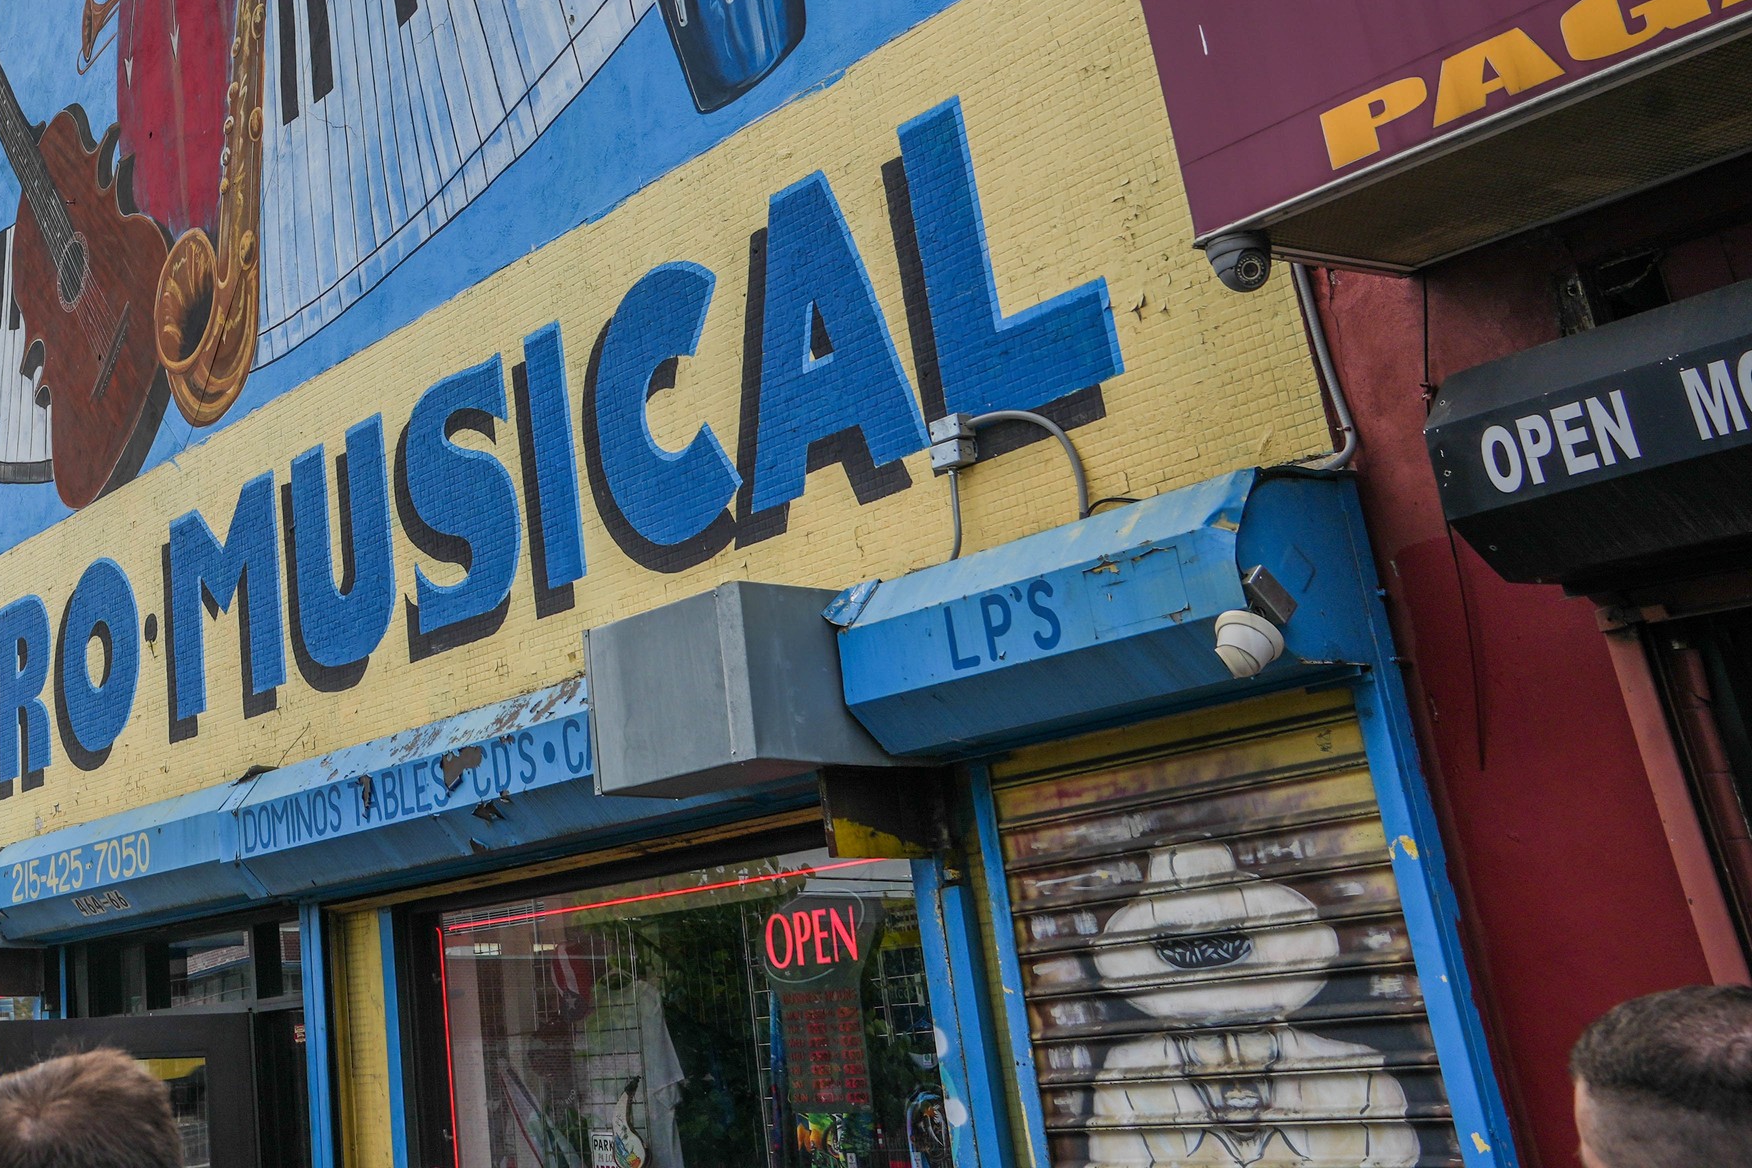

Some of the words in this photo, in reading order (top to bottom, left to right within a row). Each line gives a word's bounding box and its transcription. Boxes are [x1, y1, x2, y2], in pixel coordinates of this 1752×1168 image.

[162, 95, 1125, 744] MUSICAL
[1480, 389, 1642, 494] OPEN
[943, 579, 1062, 671] LP'S
[241, 785, 342, 854] DOMINOS
[351, 761, 449, 827] TABLES
[562, 718, 593, 775] C
[71, 889, 132, 918] 464-66
[764, 904, 859, 970] OPEN
